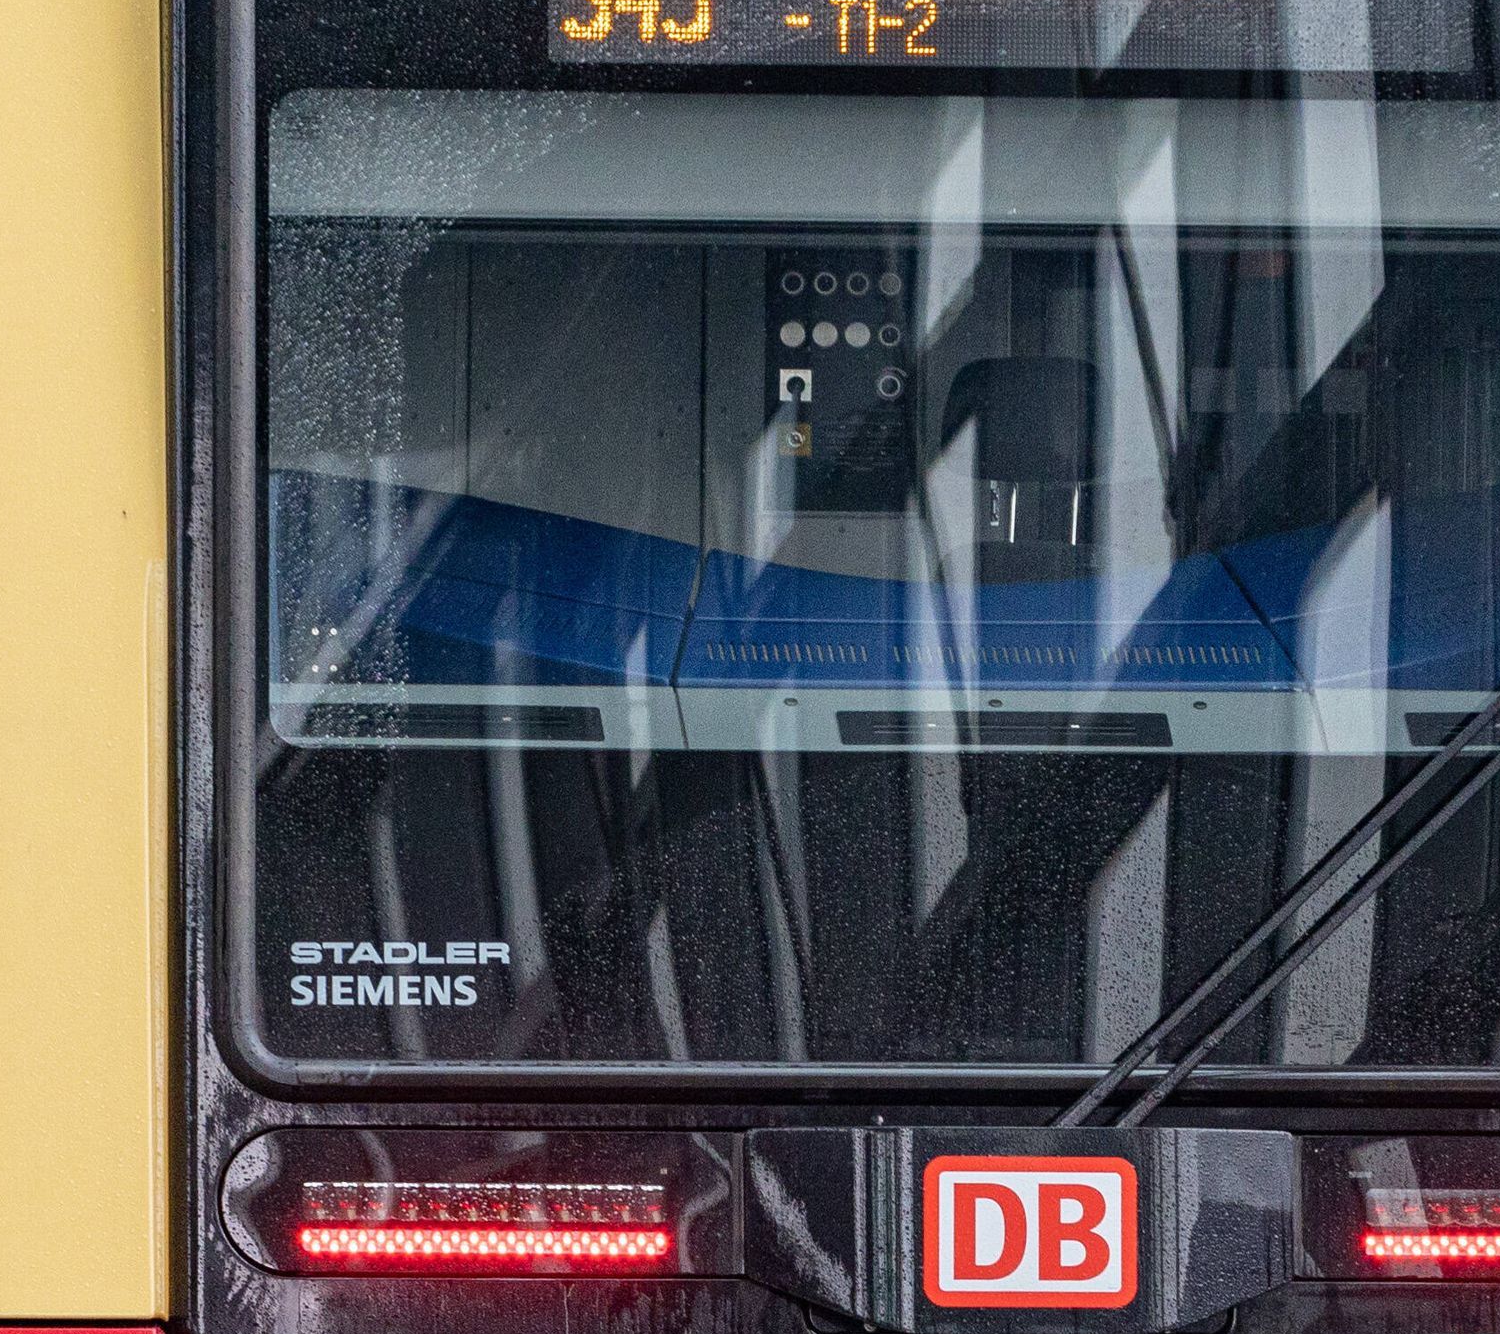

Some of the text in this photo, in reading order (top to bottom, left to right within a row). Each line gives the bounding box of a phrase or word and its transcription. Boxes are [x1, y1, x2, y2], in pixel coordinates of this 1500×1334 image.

[290, 941, 511, 965] STADLER
[290, 975, 479, 1006] SIEMENS
[950, 1182, 1113, 1282] DB
